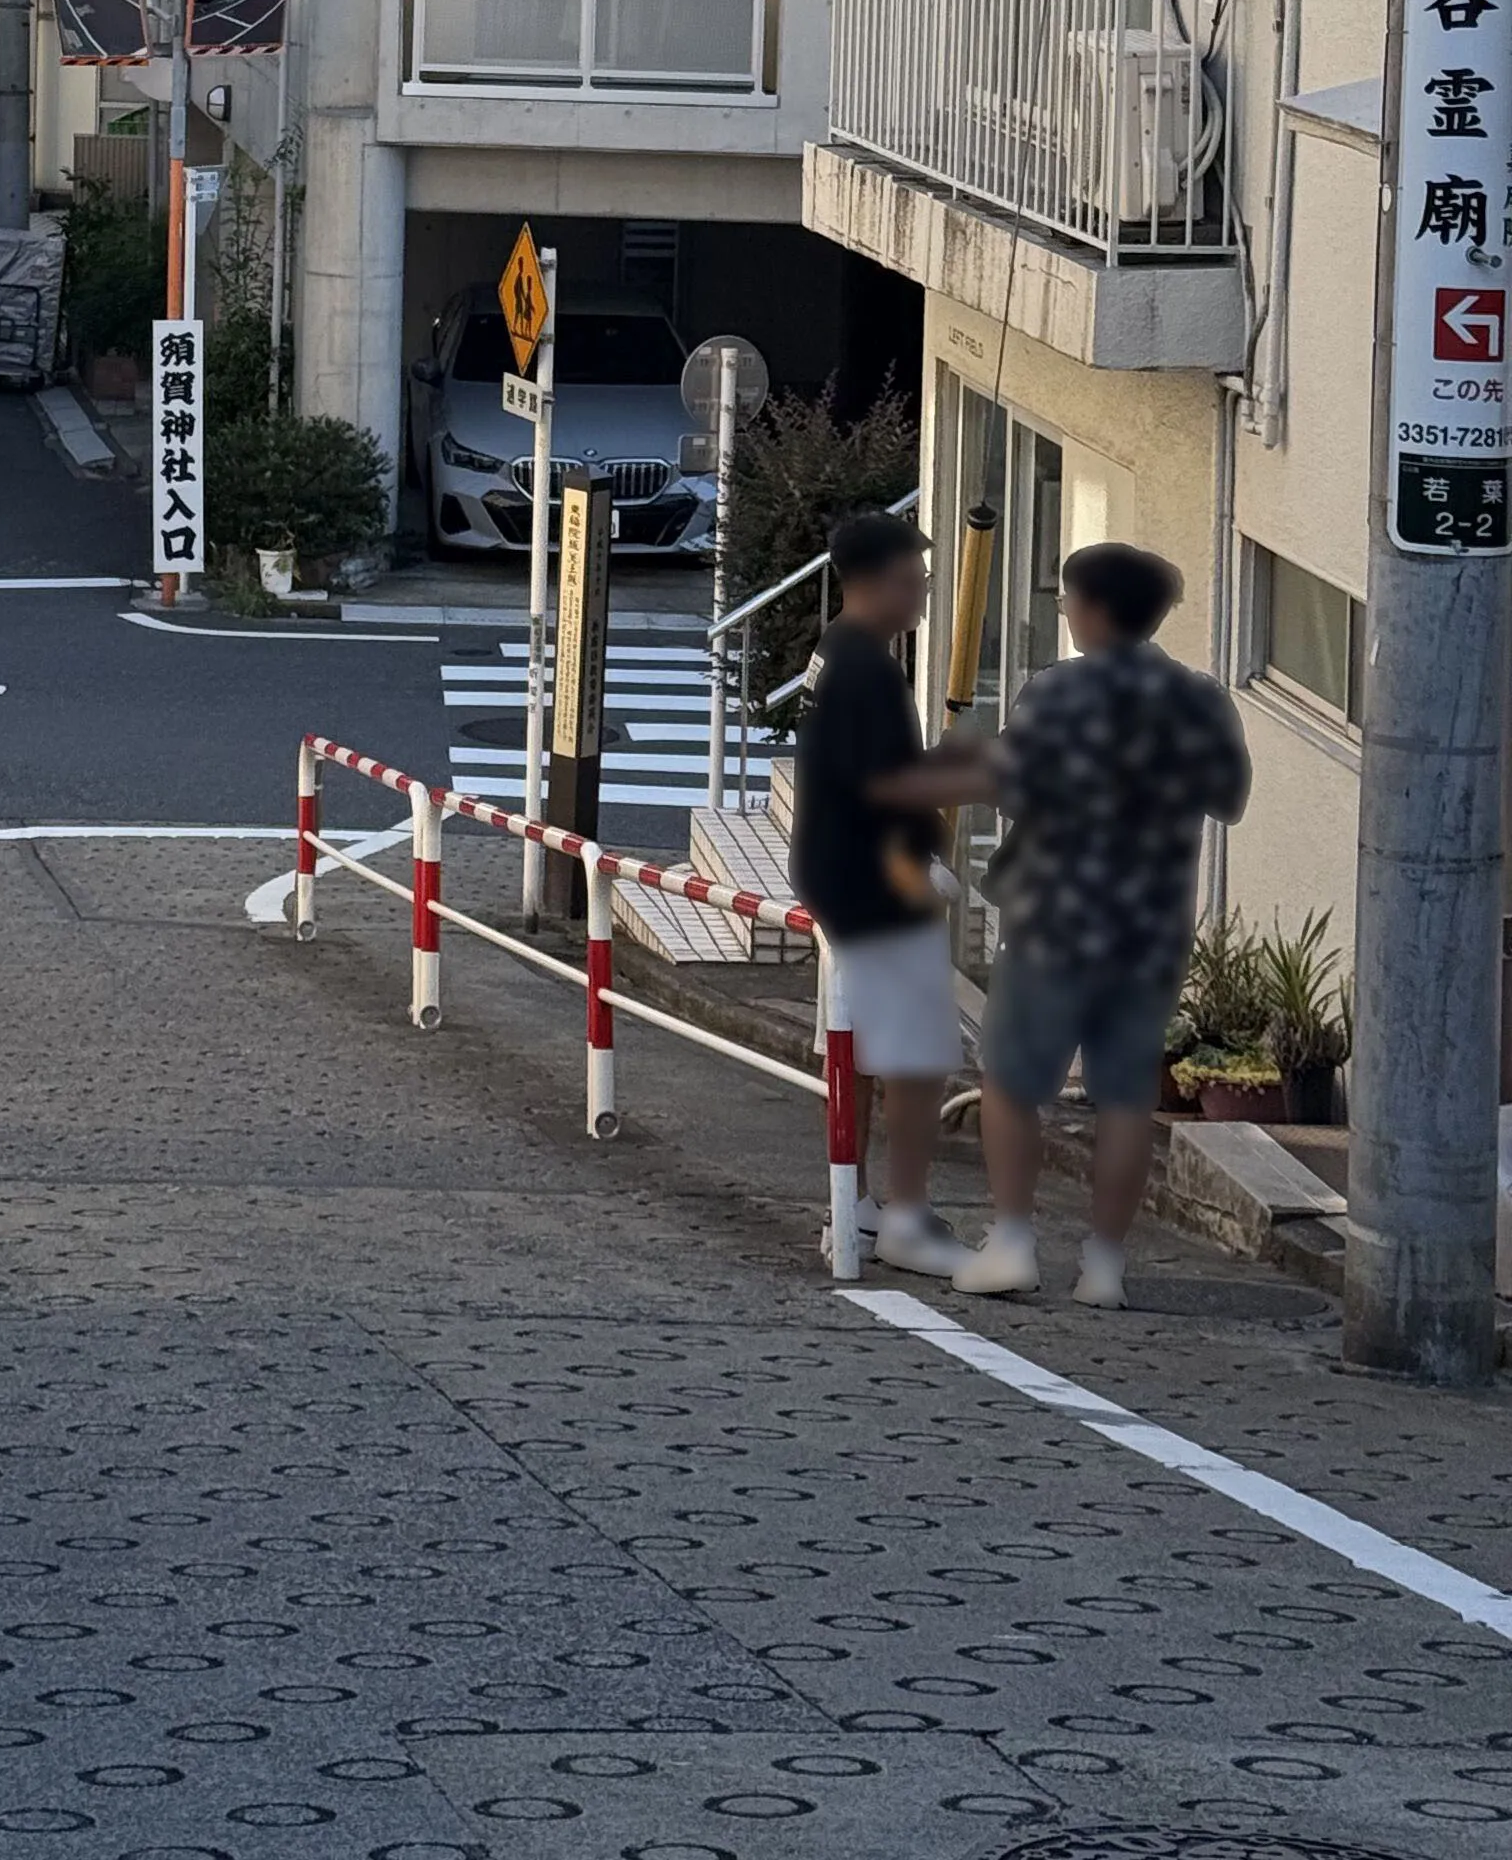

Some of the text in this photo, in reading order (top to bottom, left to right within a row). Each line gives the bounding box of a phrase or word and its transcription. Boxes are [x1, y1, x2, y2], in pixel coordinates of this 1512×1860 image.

[1432, 376, 1504, 404] この先
[160, 331, 198, 562] 須賀神社入口
[1421, 476, 1504, 505] 若葉
[1434, 510, 1493, 538] 2-2
